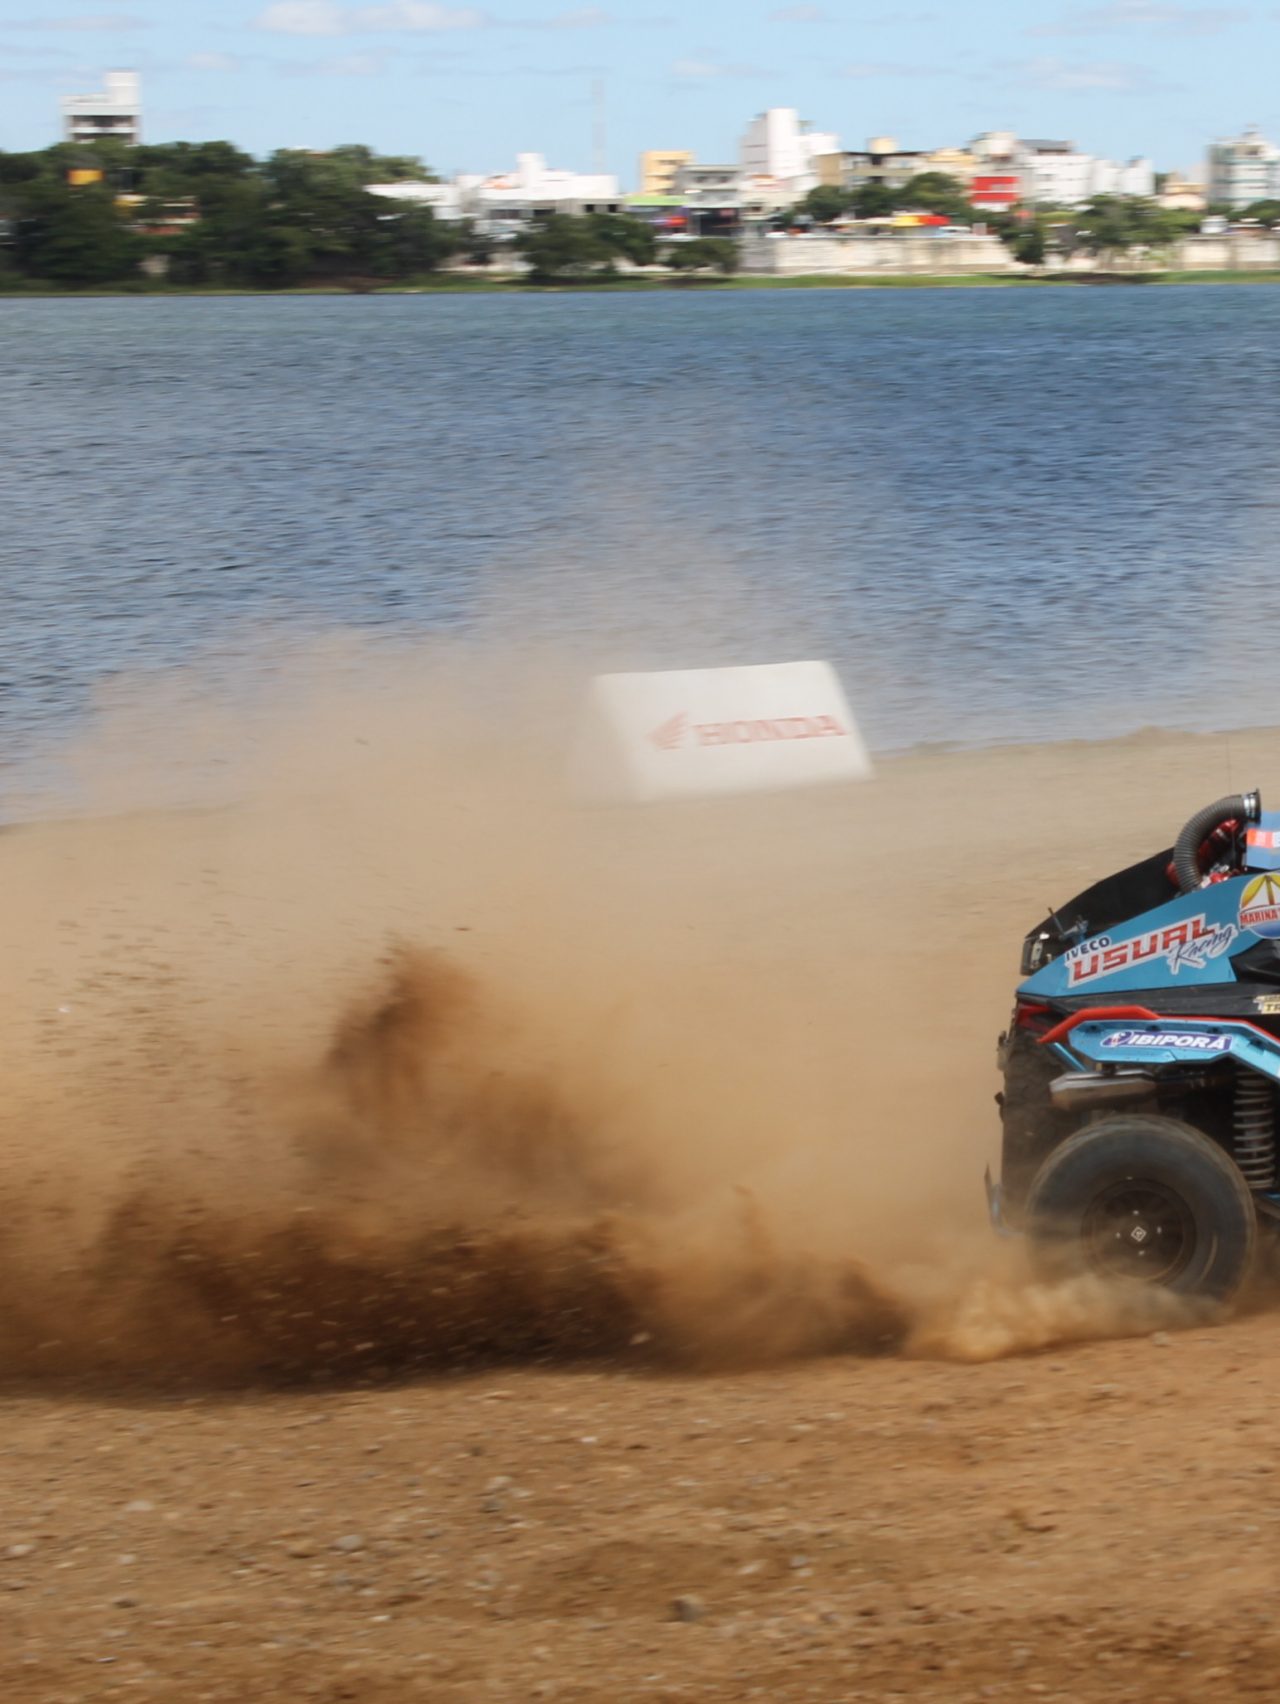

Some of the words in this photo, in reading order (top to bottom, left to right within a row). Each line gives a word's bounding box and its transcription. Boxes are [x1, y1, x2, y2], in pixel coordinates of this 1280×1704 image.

[693, 715, 848, 746] HONDA
[1240, 910, 1278, 924] MARINA
[1066, 937, 1110, 960] IVECO
[1073, 918, 1216, 982] USUAL
[1170, 925, 1234, 967] Racing
